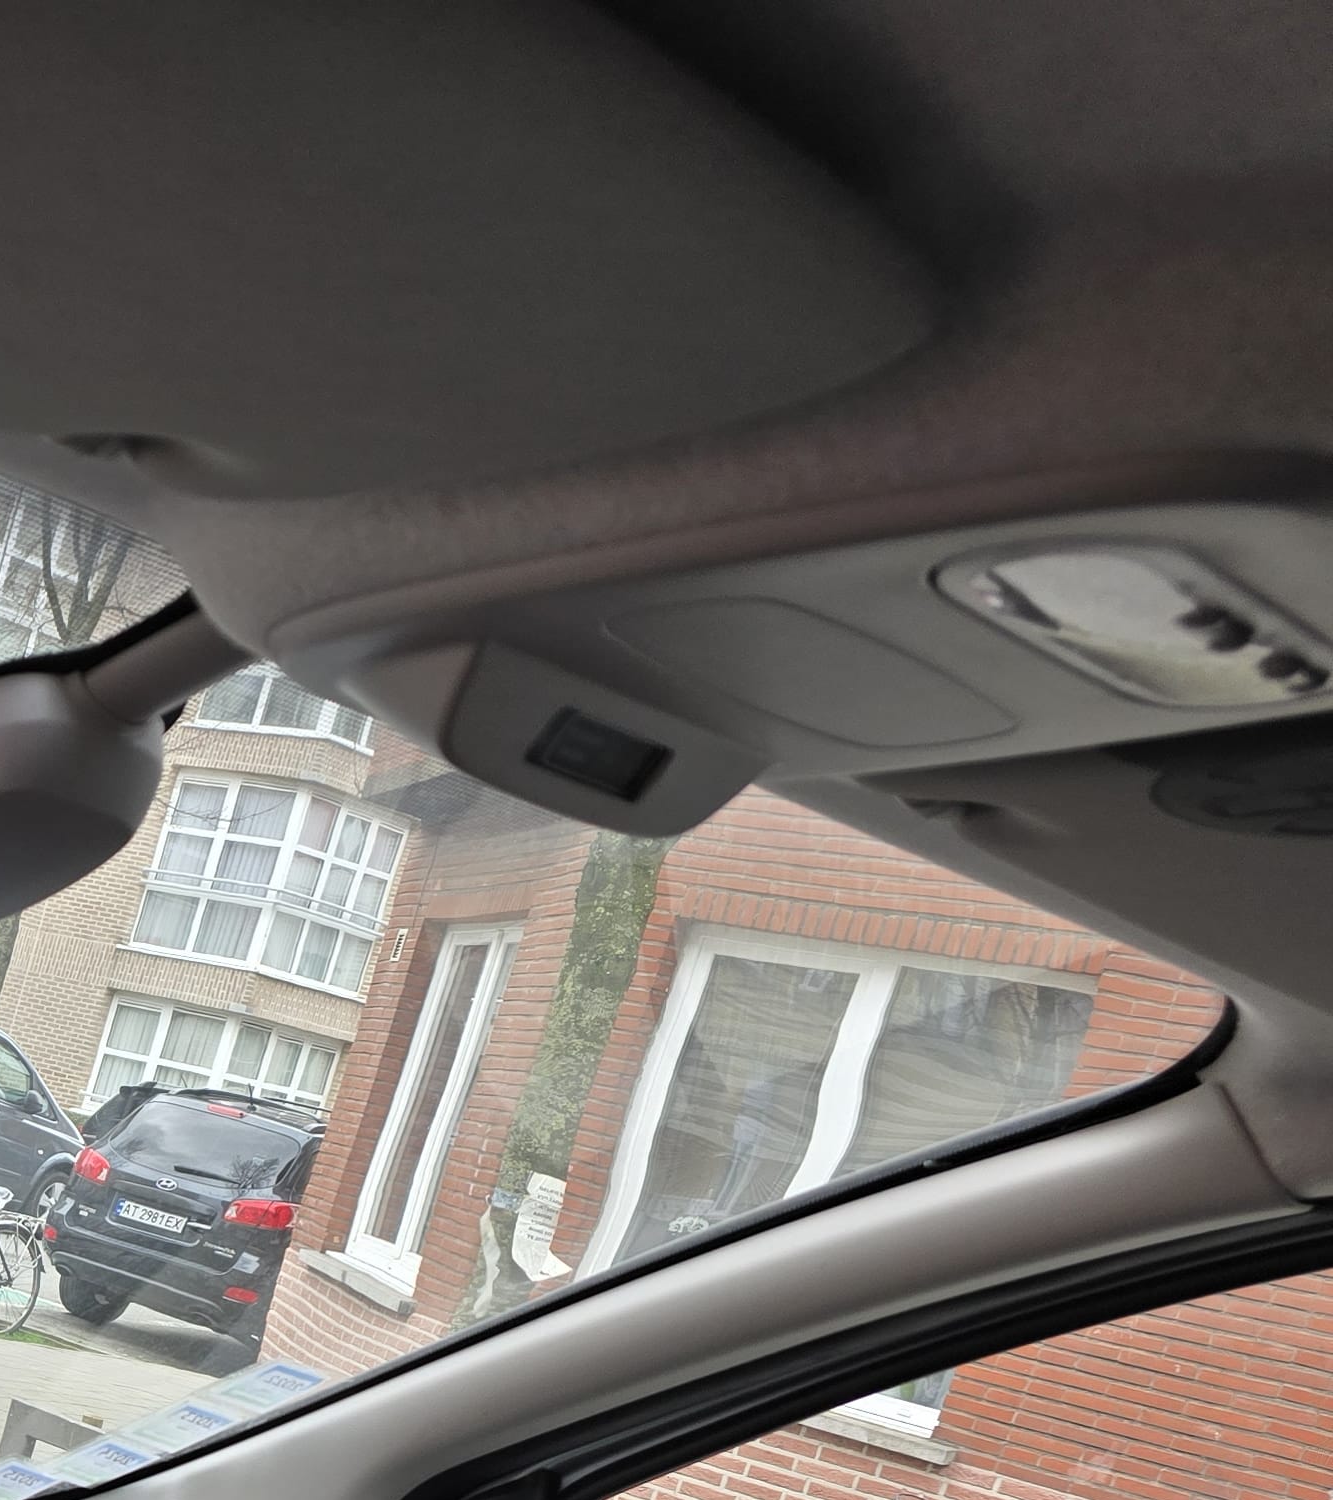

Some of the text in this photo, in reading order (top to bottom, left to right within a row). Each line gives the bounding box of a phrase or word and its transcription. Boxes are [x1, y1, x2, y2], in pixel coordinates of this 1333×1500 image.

[122, 1203, 184, 1230] AT 2981 EX
